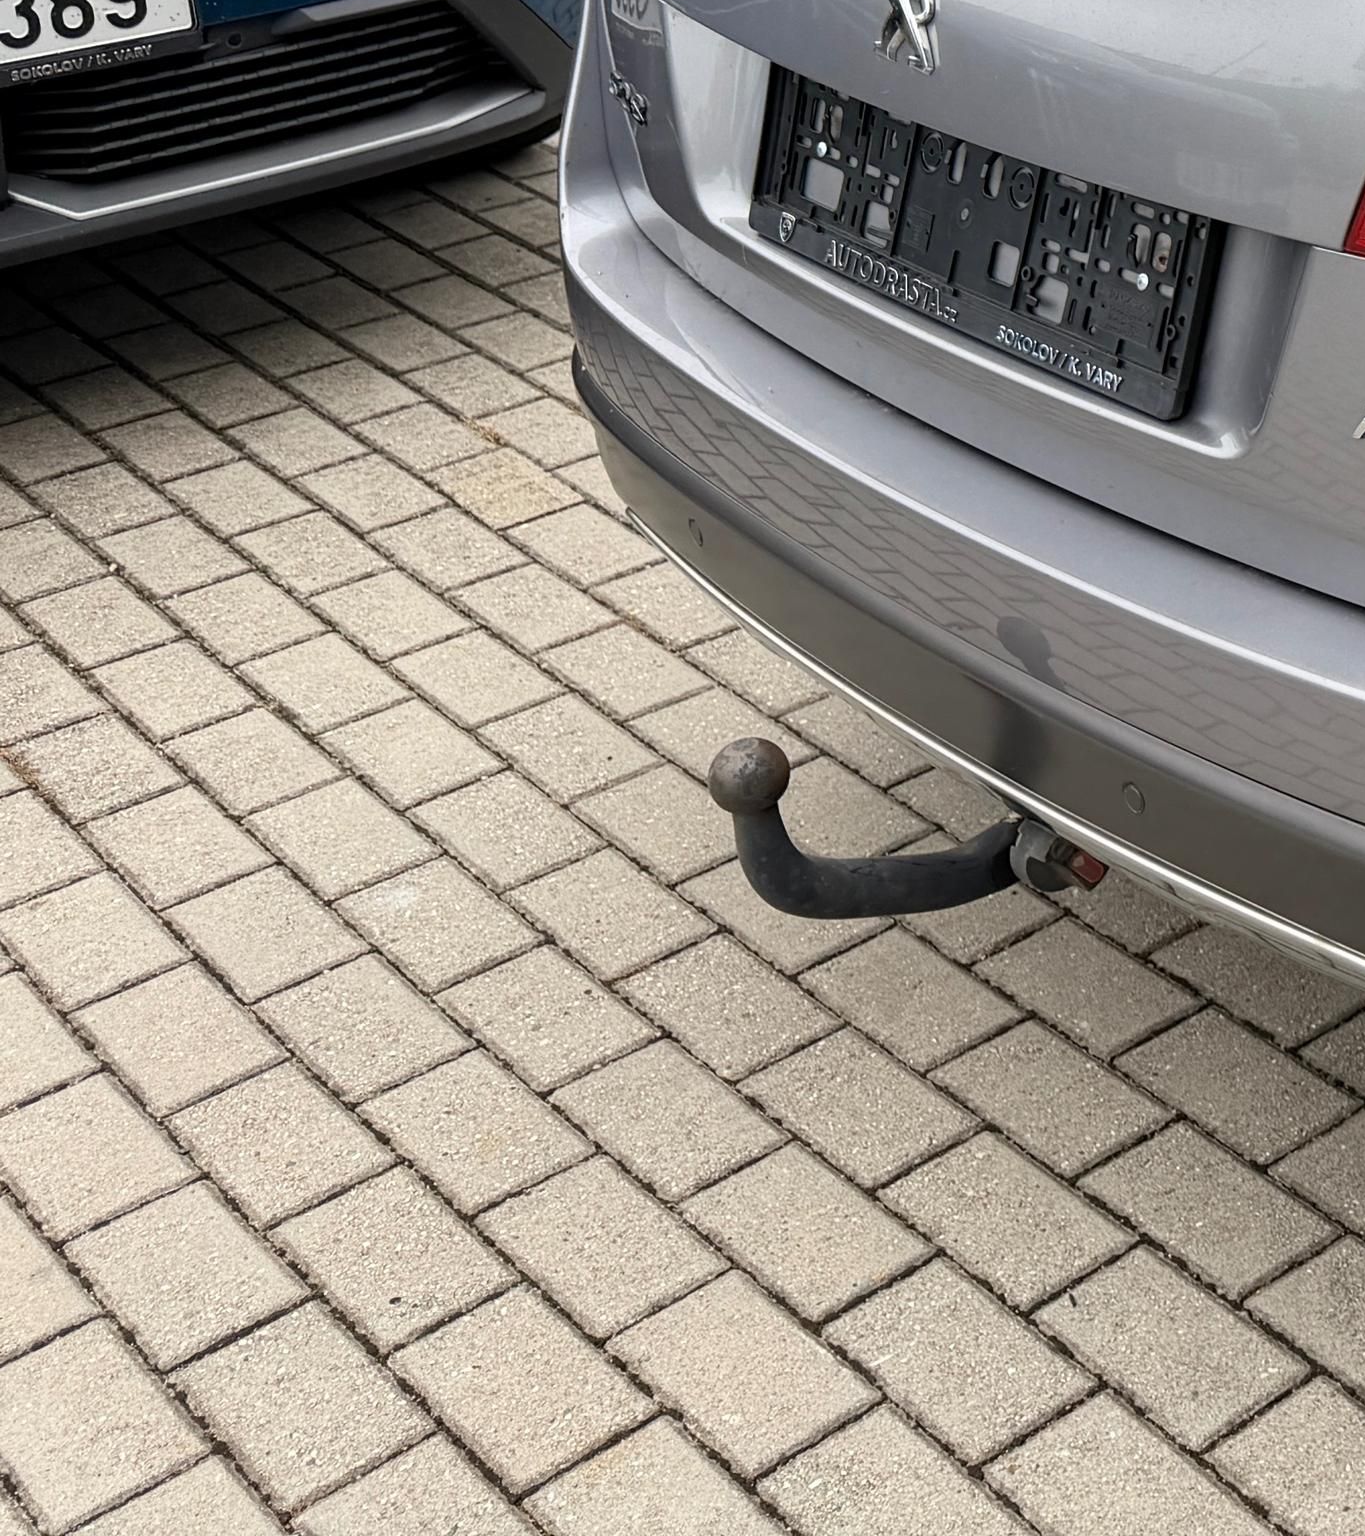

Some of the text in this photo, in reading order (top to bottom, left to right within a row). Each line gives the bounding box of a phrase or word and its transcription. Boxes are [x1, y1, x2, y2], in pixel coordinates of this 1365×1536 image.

[11, 58, 84, 82] SOKOLOV
[96, 53, 112, 65] K.
[114, 44, 153, 62] VARY
[824, 239, 958, 324] AUTODRASTA.cz
[995, 324, 1060, 365] SOKOLOV
[1086, 362, 1124, 394] VARY
